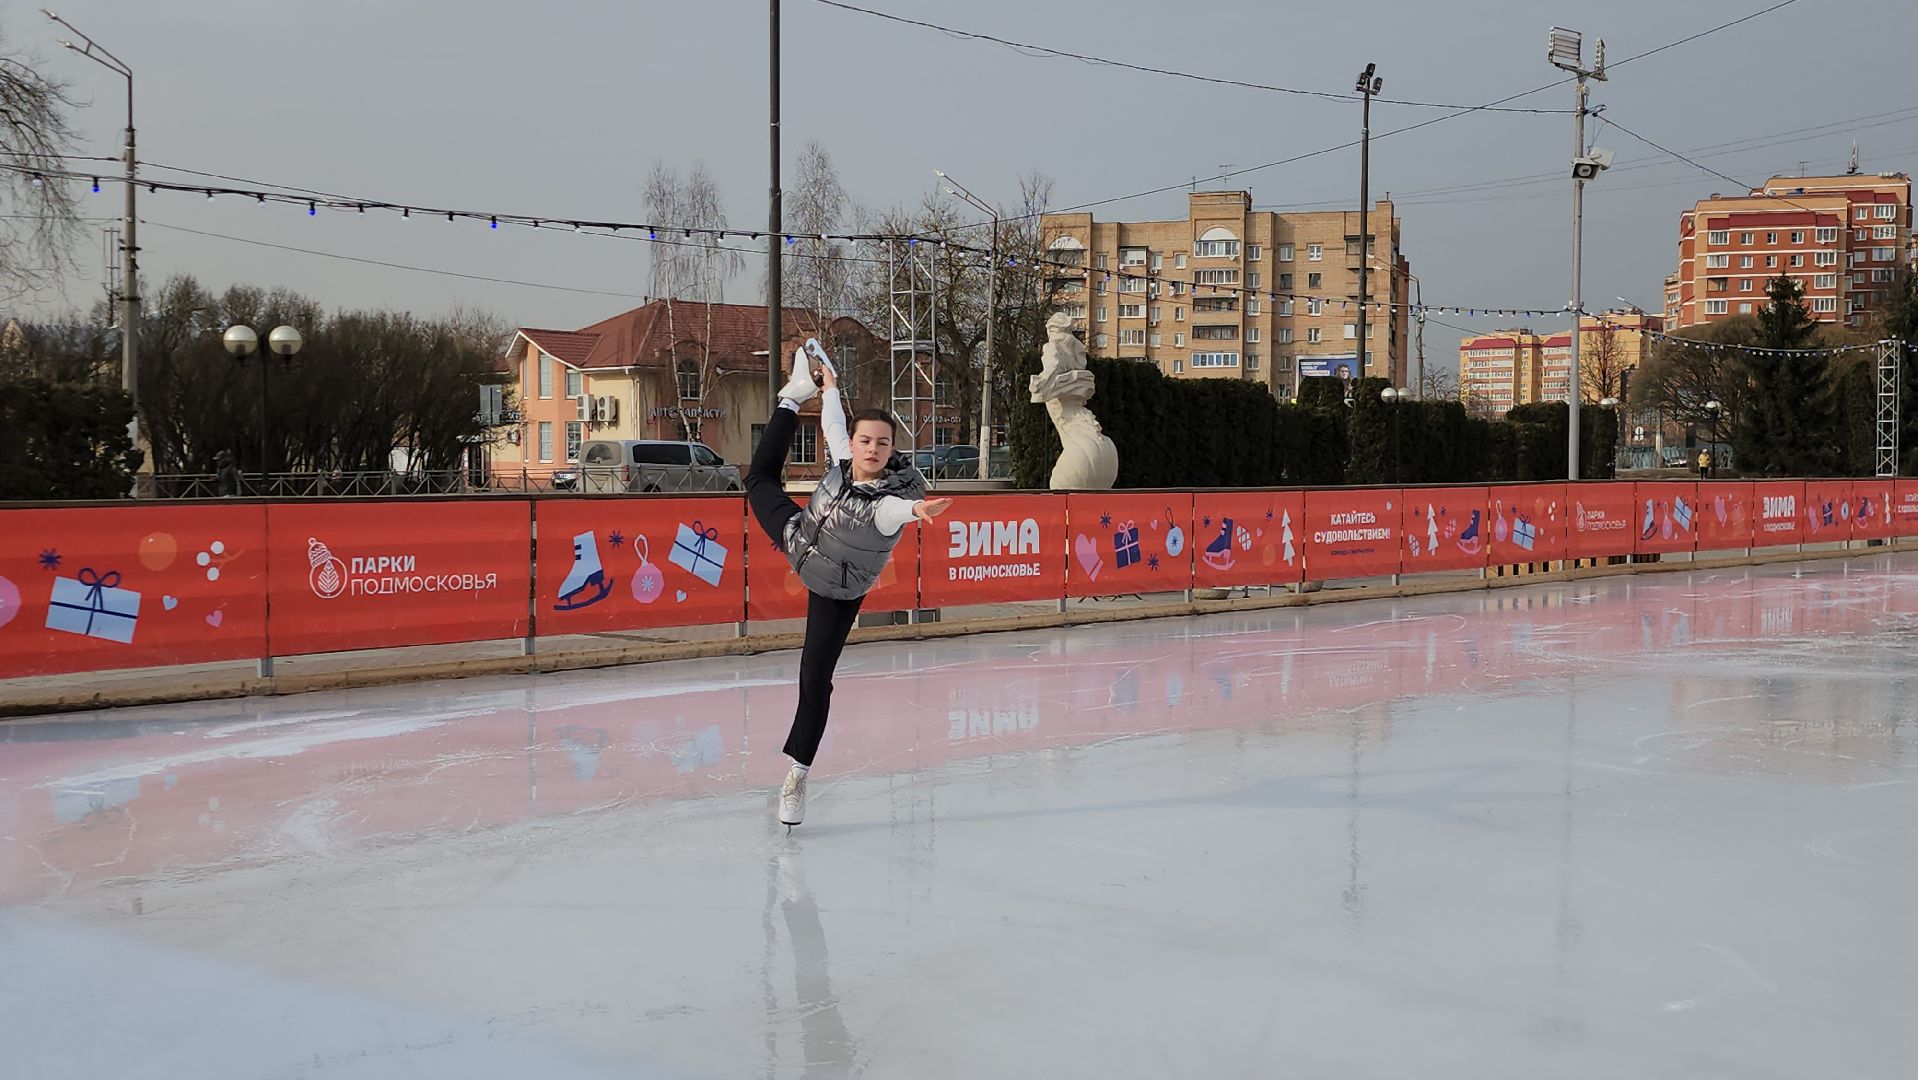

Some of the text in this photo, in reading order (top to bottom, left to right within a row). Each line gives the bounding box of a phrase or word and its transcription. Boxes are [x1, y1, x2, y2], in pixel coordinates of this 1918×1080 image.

[1330, 510, 1376, 526] КАТАЙТЕСЬ
[1763, 495, 1796, 519] ЗИМА
[948, 518, 1040, 559] ЗИМА
[351, 554, 416, 574] ПАРКИ
[948, 562, 1041, 581] В ПОДМОСКОВЬЕ
[351, 573, 497, 597] ПОДМОСКОВЬЯ
